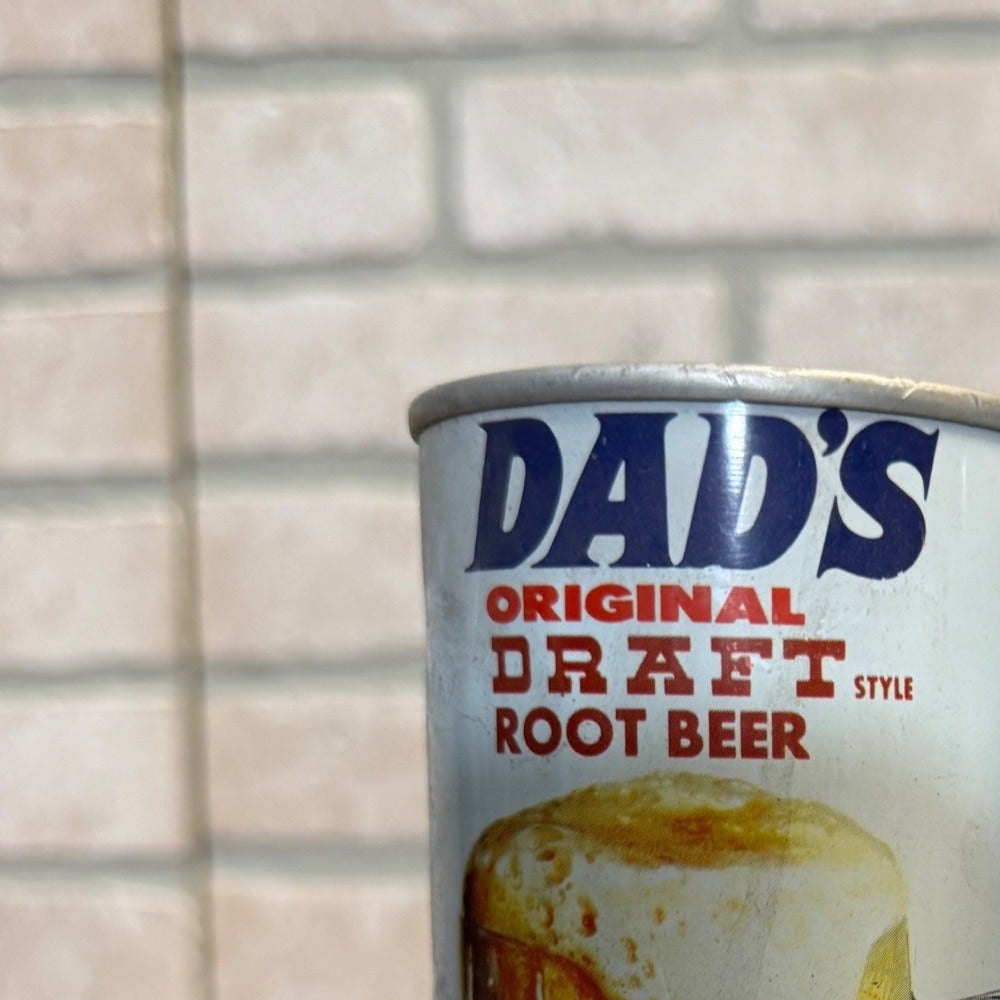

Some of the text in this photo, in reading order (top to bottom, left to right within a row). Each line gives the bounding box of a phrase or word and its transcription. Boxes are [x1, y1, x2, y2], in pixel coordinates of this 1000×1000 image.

[465, 407, 939, 580] DAD'S
[486, 584, 805, 625] ORIGINAL
[491, 635, 914, 701] DRAFT STYLE
[495, 707, 810, 760] ROOT BEER
